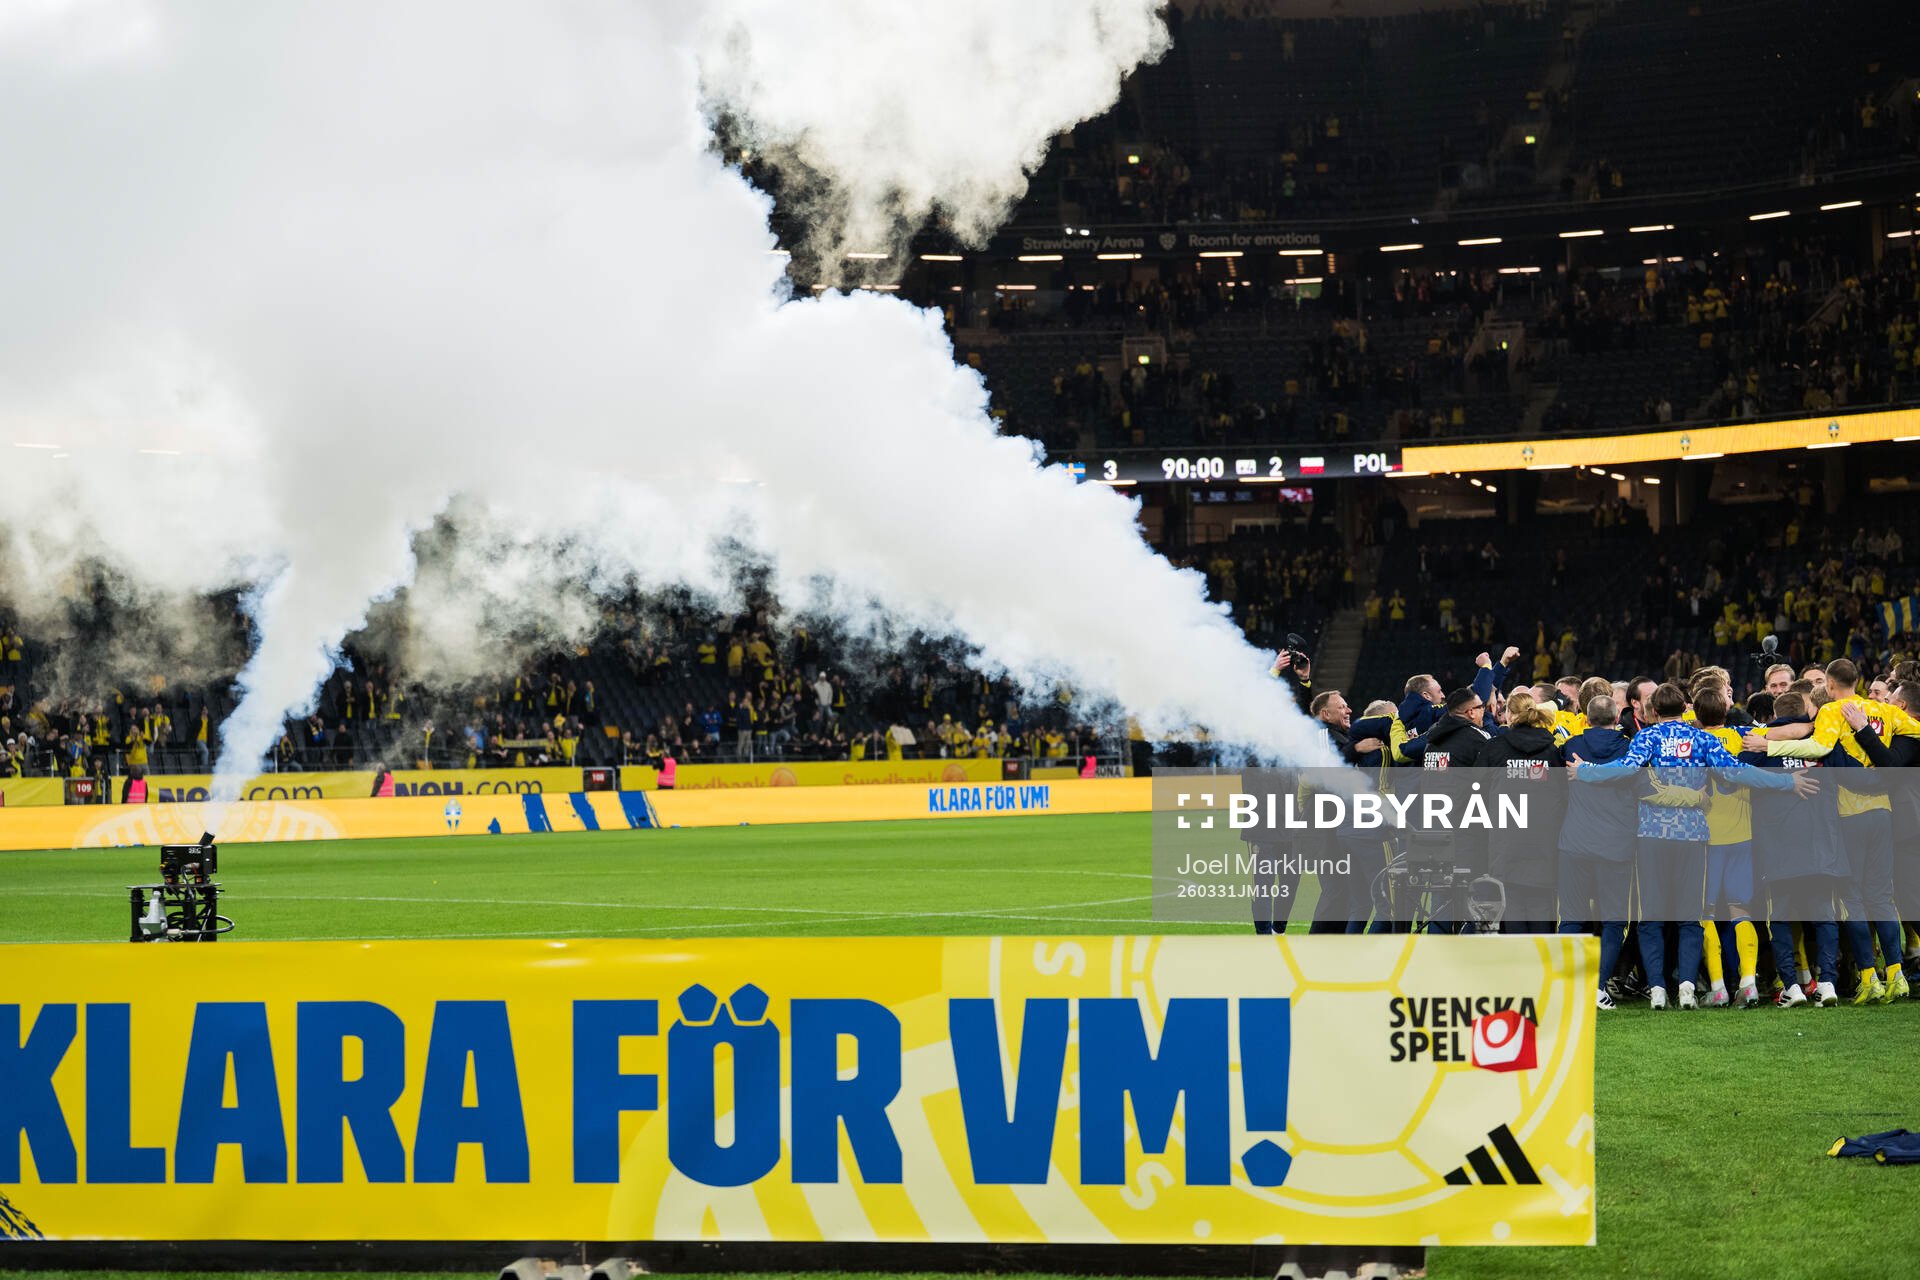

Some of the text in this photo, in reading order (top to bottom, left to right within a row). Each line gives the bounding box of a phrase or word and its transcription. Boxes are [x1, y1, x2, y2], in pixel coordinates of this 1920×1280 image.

[1023, 236, 1144, 250] Strawberry Arena
[1189, 233, 1321, 247] Room for emotions
[1103, 460, 1118, 480] 3
[1161, 457, 1224, 479] 90:00
[1269, 456, 1284, 477] 2
[1353, 453, 1392, 473] POL
[1782, 758, 1804, 769] SPEL
[1506, 769, 1529, 779] SPEL
[76, 783, 92, 793] 109
[929, 785, 1049, 812] KLARA FÖR VM!
[1390, 996, 1538, 1029] SVENSKA
[1390, 1030, 1466, 1062] SPEL
[0, 983, 1293, 1187] KLARA FÖR VM!
